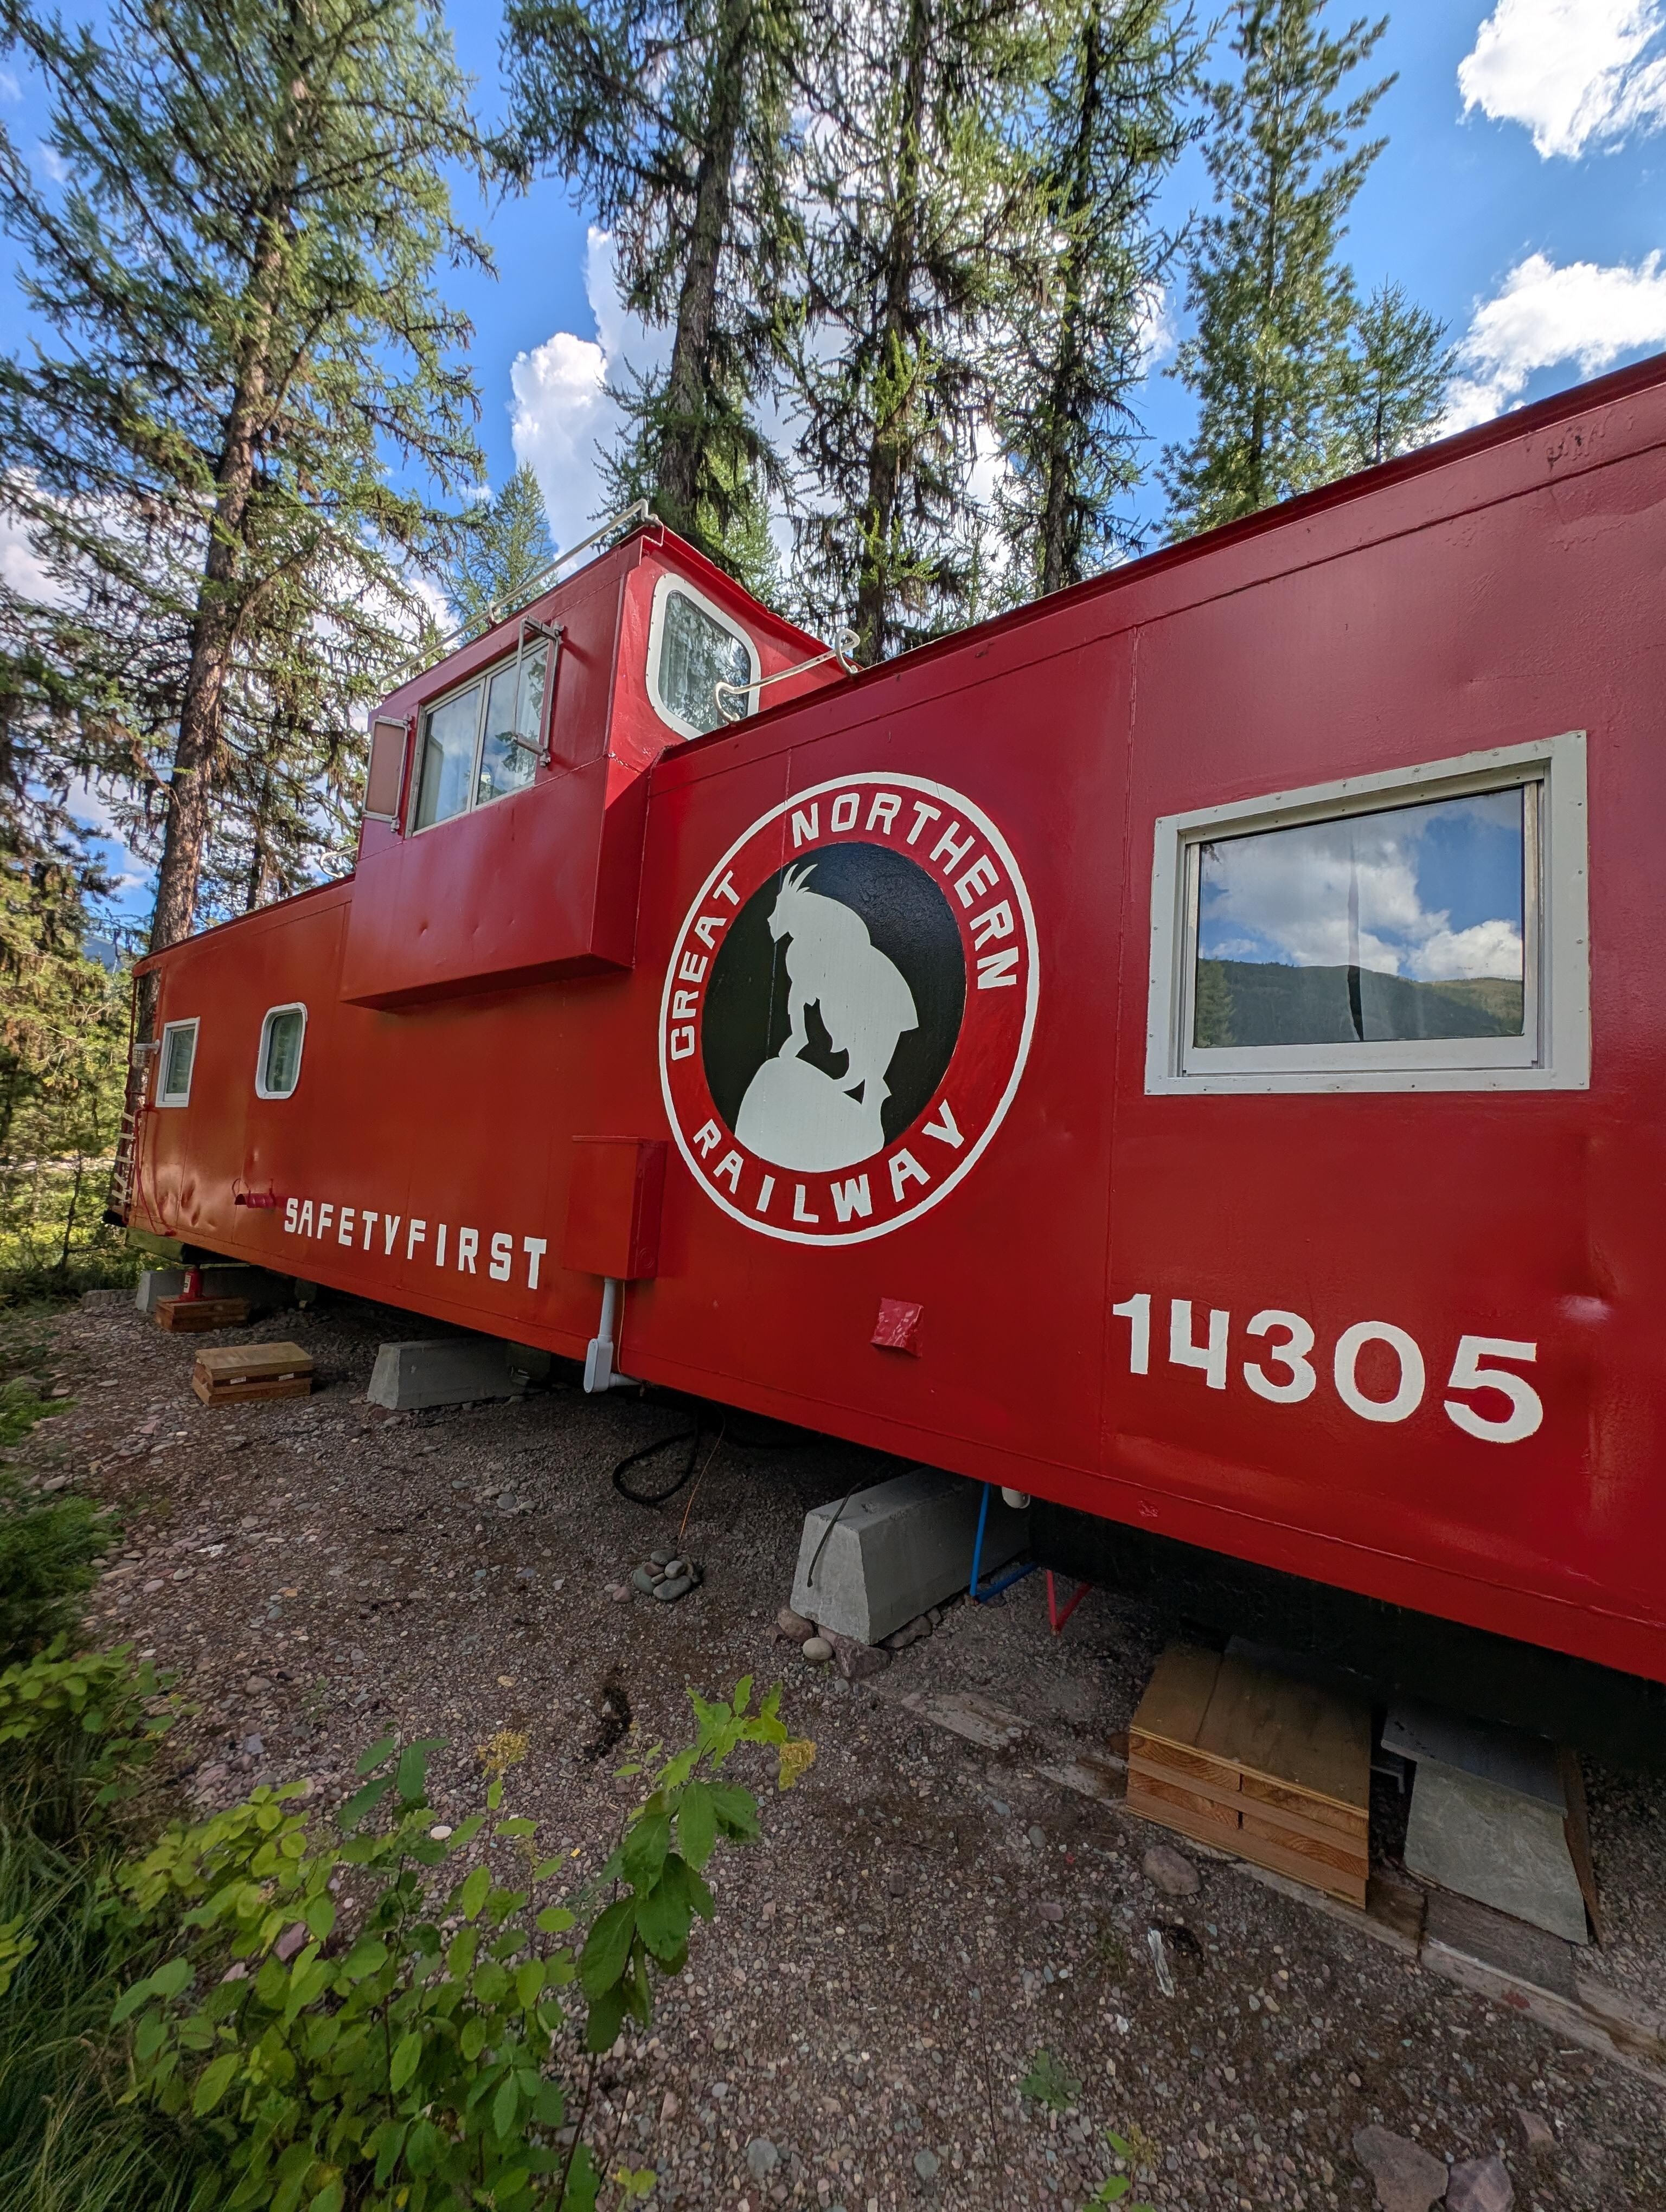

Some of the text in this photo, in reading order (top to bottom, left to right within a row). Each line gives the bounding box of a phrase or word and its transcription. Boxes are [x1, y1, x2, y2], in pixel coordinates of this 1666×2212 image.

[670, 792, 1020, 1062] GREAT NORTHERN
[692, 1098, 965, 1224] RAILWAY
[1112, 1293, 1544, 1444] 14305
